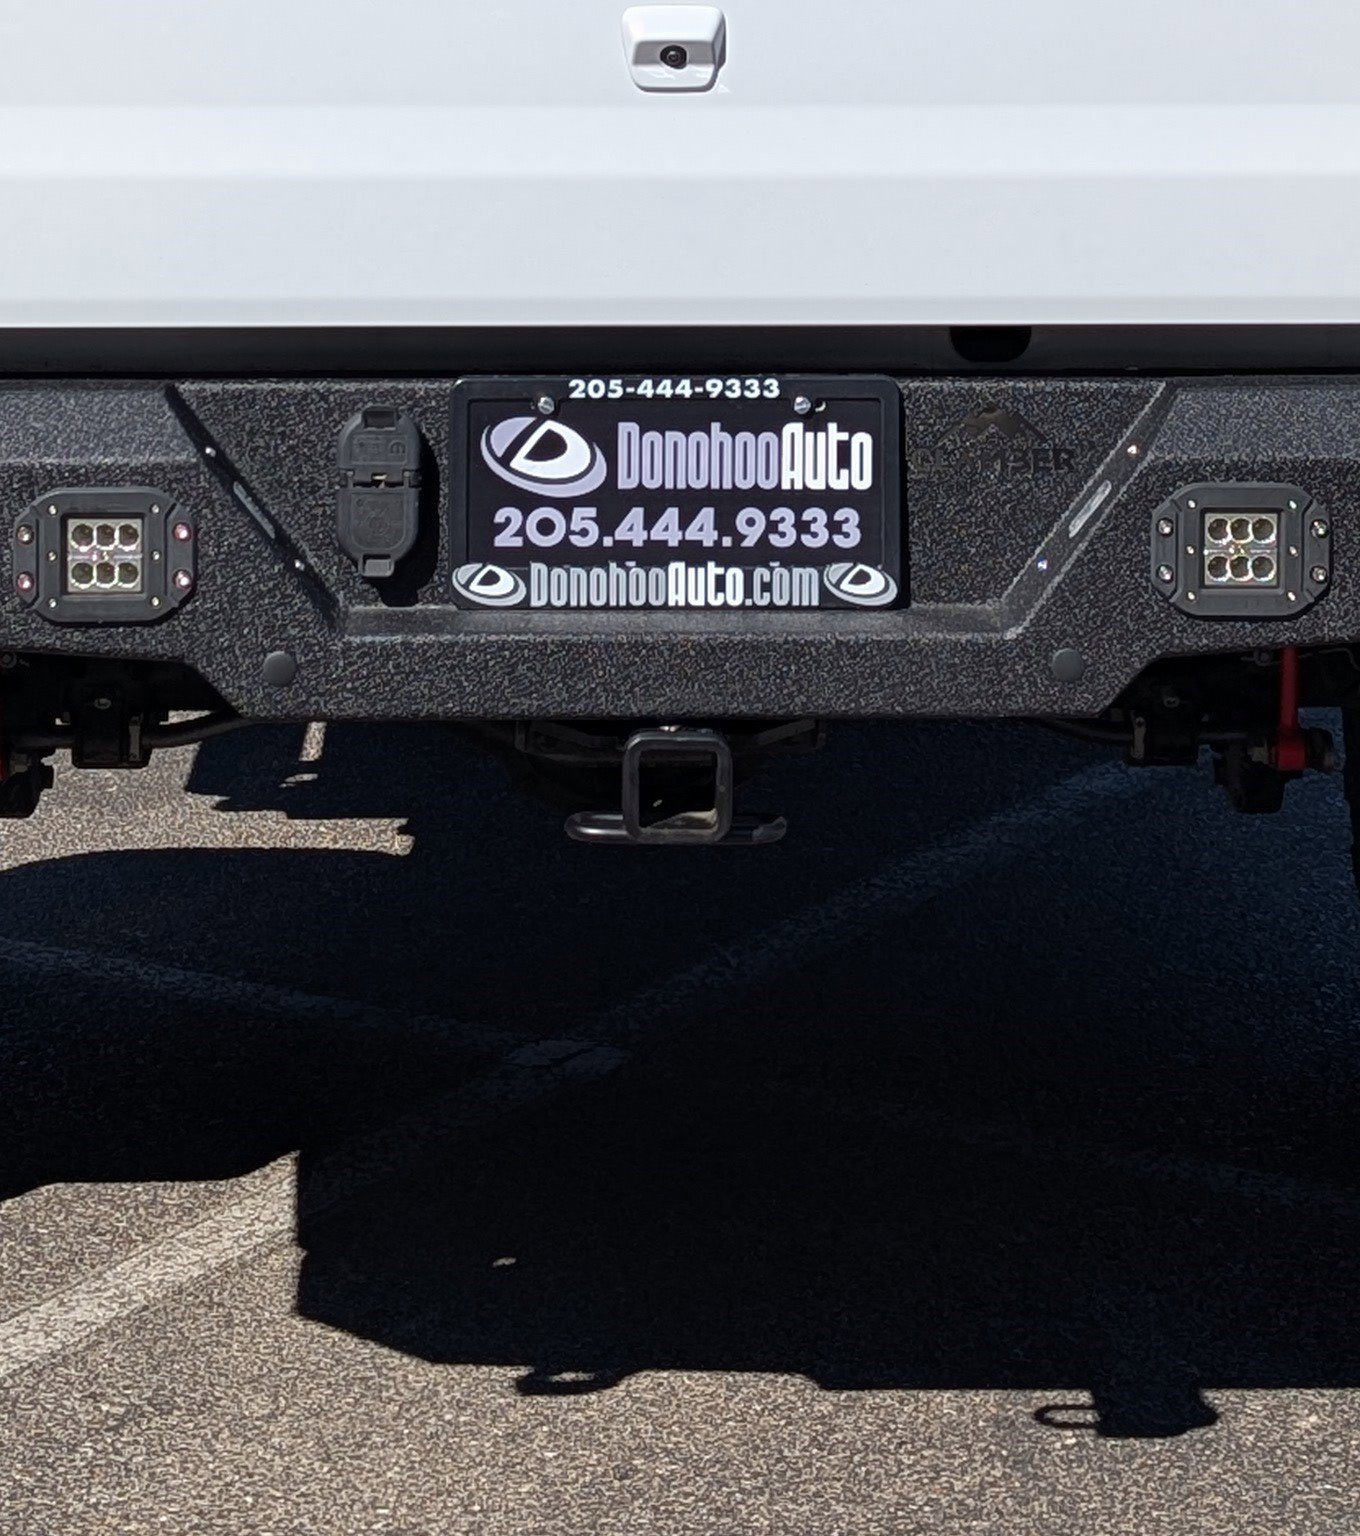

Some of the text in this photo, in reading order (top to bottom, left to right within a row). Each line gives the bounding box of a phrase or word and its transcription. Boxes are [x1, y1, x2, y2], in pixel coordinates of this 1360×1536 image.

[568, 378, 781, 399] 205-444-9333
[617, 421, 873, 491] DonohooAuto
[493, 506, 862, 548] 205.444.9333
[530, 561, 820, 607] DonohooAuto.com
